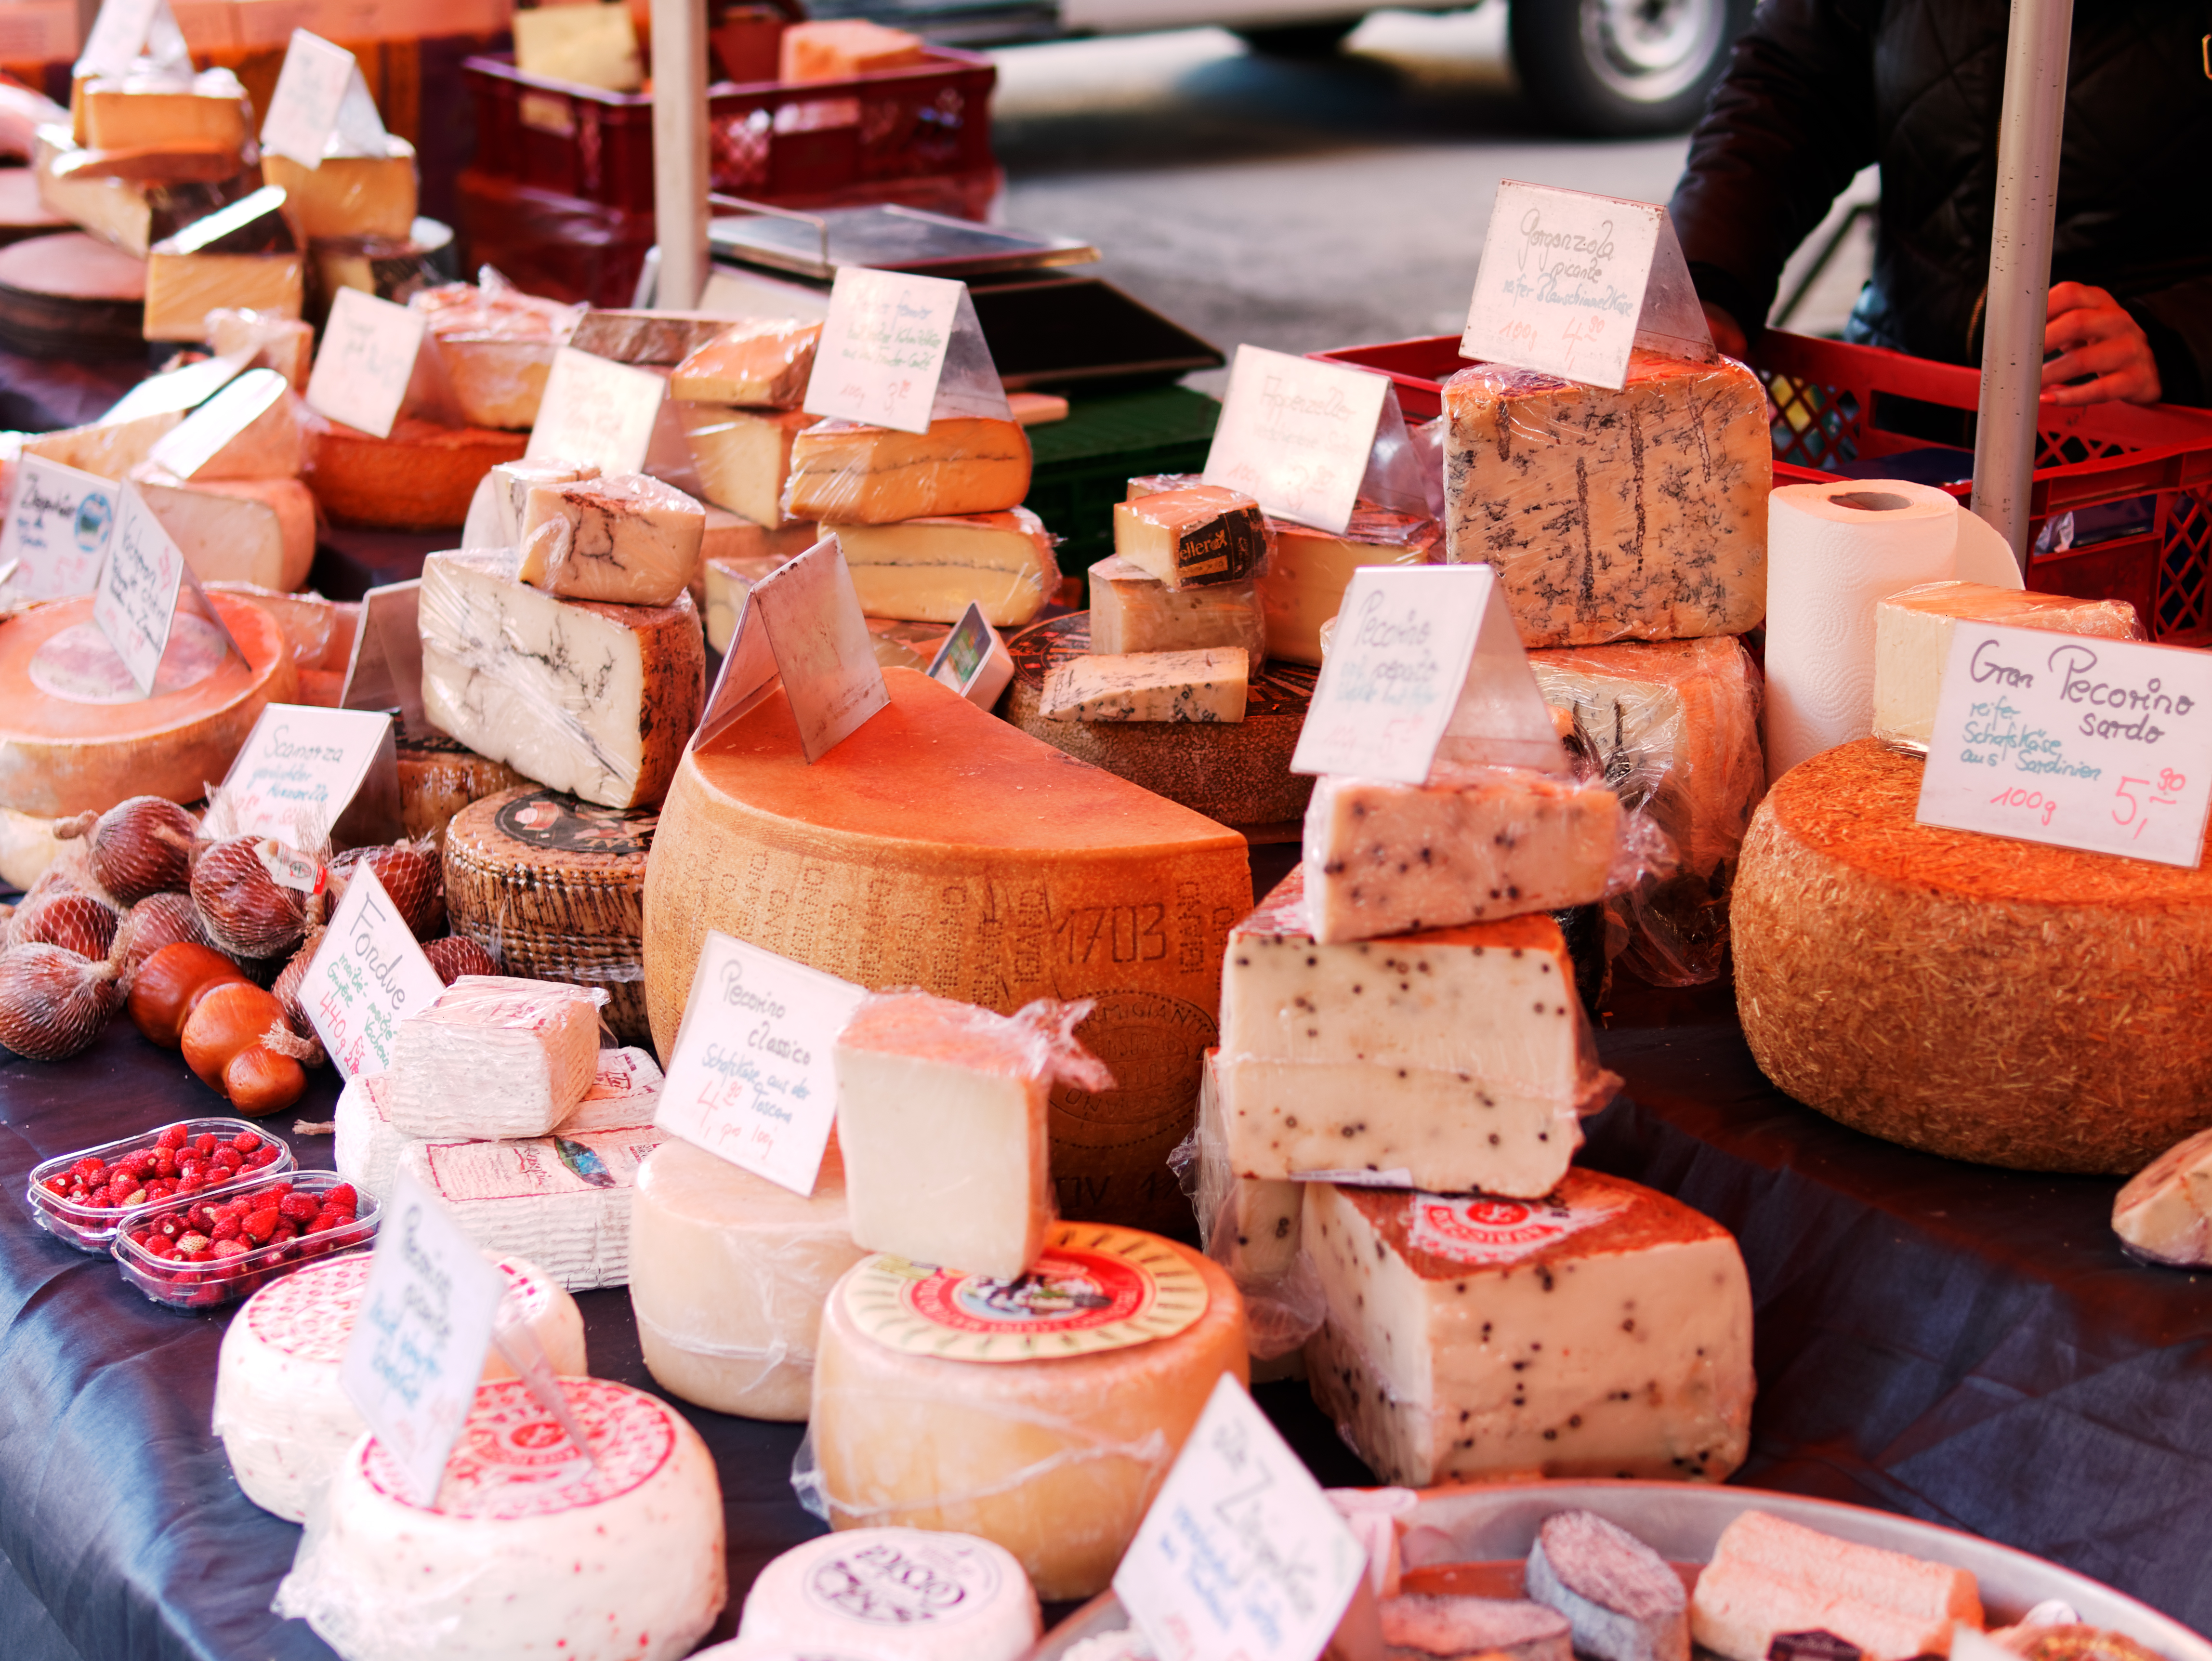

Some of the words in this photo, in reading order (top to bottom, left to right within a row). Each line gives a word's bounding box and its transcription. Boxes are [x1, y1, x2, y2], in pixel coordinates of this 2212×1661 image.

[1550, 258, 1602, 283] picante
[1502, 274, 1534, 307] reifer
[1499, 320, 1537, 352] 100g
[1970, 639, 2033, 688] Gran
[2048, 645, 2195, 715] Pecorino
[1969, 696, 2021, 731] reifer
[2079, 712, 2164, 743] sardo
[1961, 749, 1998, 766] aus
[2015, 749, 2101, 781] Sardinien
[1990, 787, 2056, 826] 100g
[1057, 902, 1166, 964] 1703
[350, 892, 405, 1010] Fondue
[720, 959, 786, 1019] Pecorino
[1073, 1003, 1204, 1035] ARMIGIANO
[748, 1020, 811, 1065] classico
